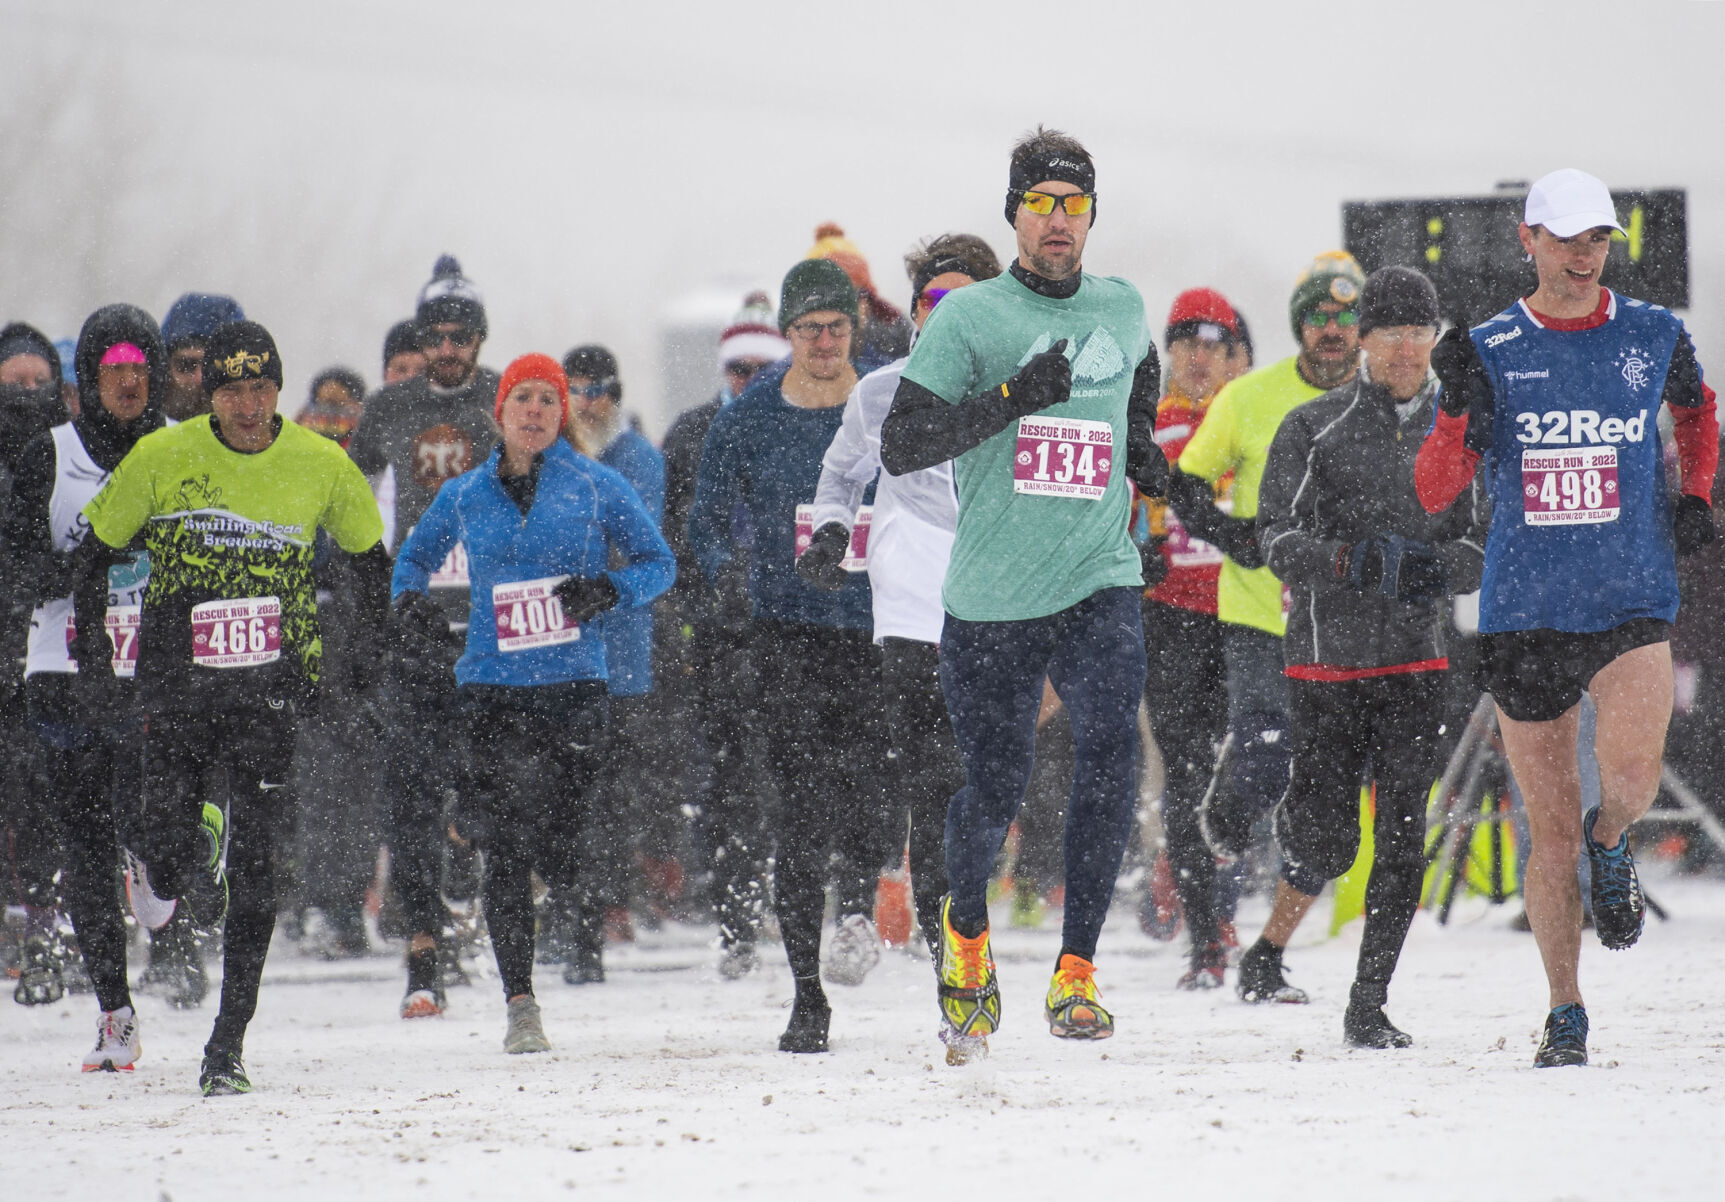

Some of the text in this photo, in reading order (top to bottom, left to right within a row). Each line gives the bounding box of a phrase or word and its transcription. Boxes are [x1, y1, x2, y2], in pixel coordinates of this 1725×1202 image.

[1059, 160, 1080, 171] asics
[1485, 325, 1522, 348] 32Red
[1515, 369, 1549, 379] hummel
[1020, 424, 1112, 443] RESCUE RUN 2022
[1515, 409, 1648, 444] 32Red
[1033, 441, 1096, 485] 134
[1523, 454, 1616, 469] RESCUE RUN 2022
[1079, 486, 1103, 496] BELOW
[1540, 470, 1603, 510] 498
[1588, 510, 1612, 519] BELOW
[184, 518, 256, 534] Smiling
[204, 534, 283, 551] Brewery
[494, 587, 544, 602] RESCUE RUN
[193, 608, 229, 621] RESCUE
[231, 606, 250, 617] RUN
[257, 603, 280, 615] 2022
[510, 596, 564, 636] 400
[208, 618, 266, 655] 466
